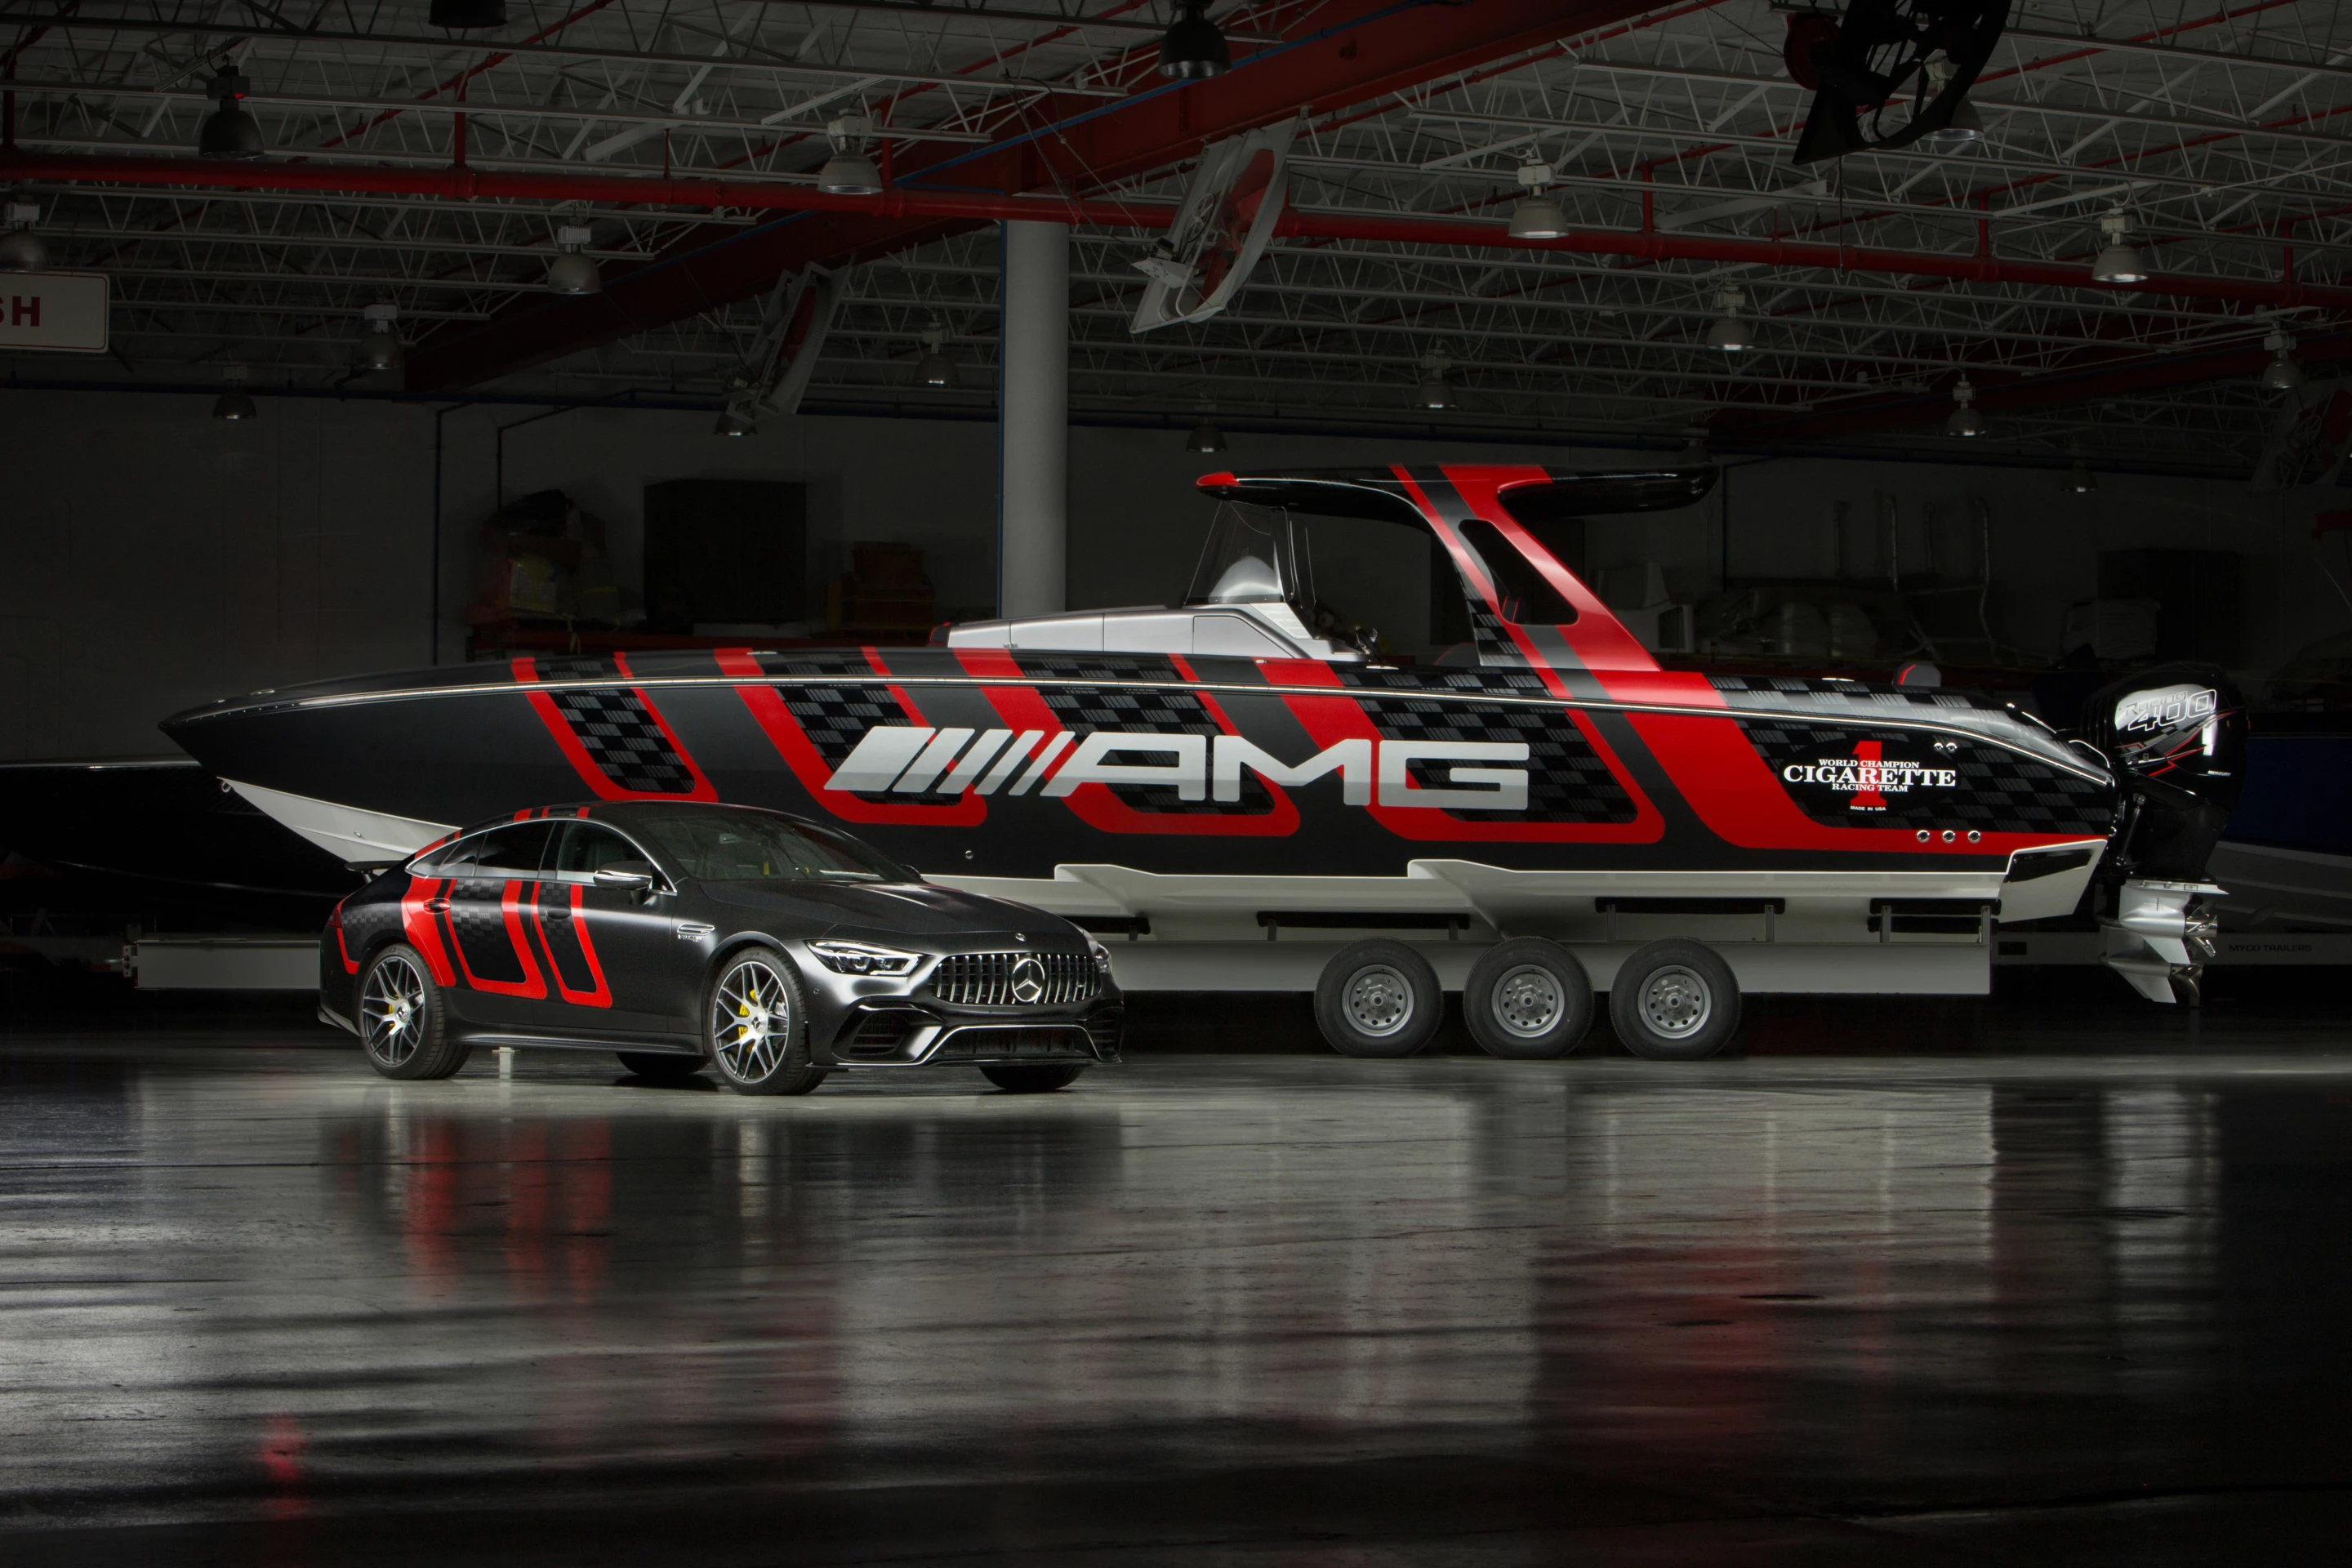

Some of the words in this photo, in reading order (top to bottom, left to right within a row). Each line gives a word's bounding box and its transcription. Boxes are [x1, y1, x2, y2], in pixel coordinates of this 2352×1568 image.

[0, 296, 40, 327] H
[2127, 689, 2217, 732] 400
[1039, 731, 1530, 810] AMG
[1783, 764, 1957, 787] CIGARETTE
[1818, 759, 1858, 767] WORLD
[1860, 760, 1920, 769] CHAMPION
[1832, 783, 1875, 791] RACING
[1877, 784, 1909, 792] TEAM
[2263, 944, 2313, 952] TRAILERS
